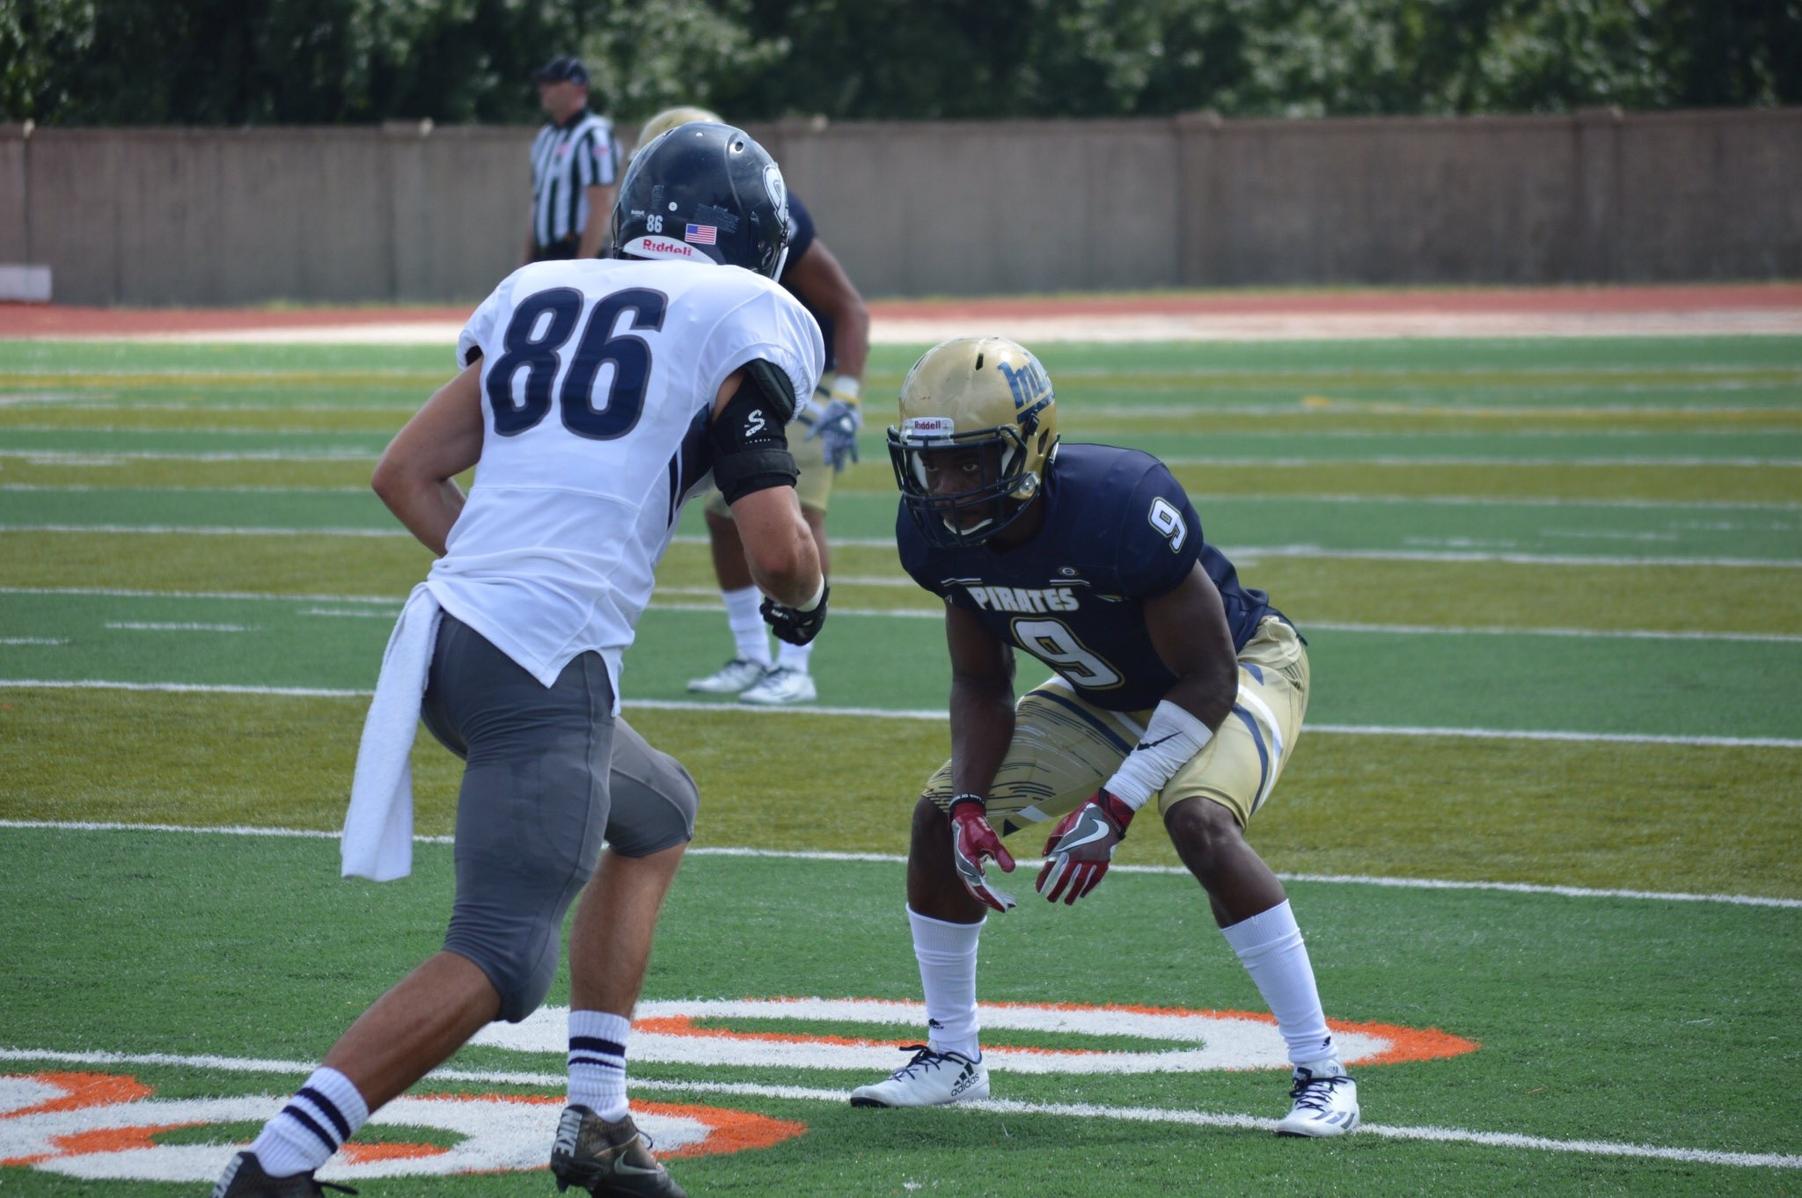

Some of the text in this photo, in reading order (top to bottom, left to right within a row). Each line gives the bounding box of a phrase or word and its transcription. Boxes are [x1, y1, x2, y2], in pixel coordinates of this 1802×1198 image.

[646, 214, 663, 233] 86
[486, 286, 669, 441] 86
[914, 420, 941, 430] Riddell
[1148, 496, 1188, 553] 9
[966, 586, 1080, 613] PIRATES
[1010, 617, 1126, 690] 9
[951, 1073, 980, 1097] adidas
[553, 1109, 583, 1158] NIKE
